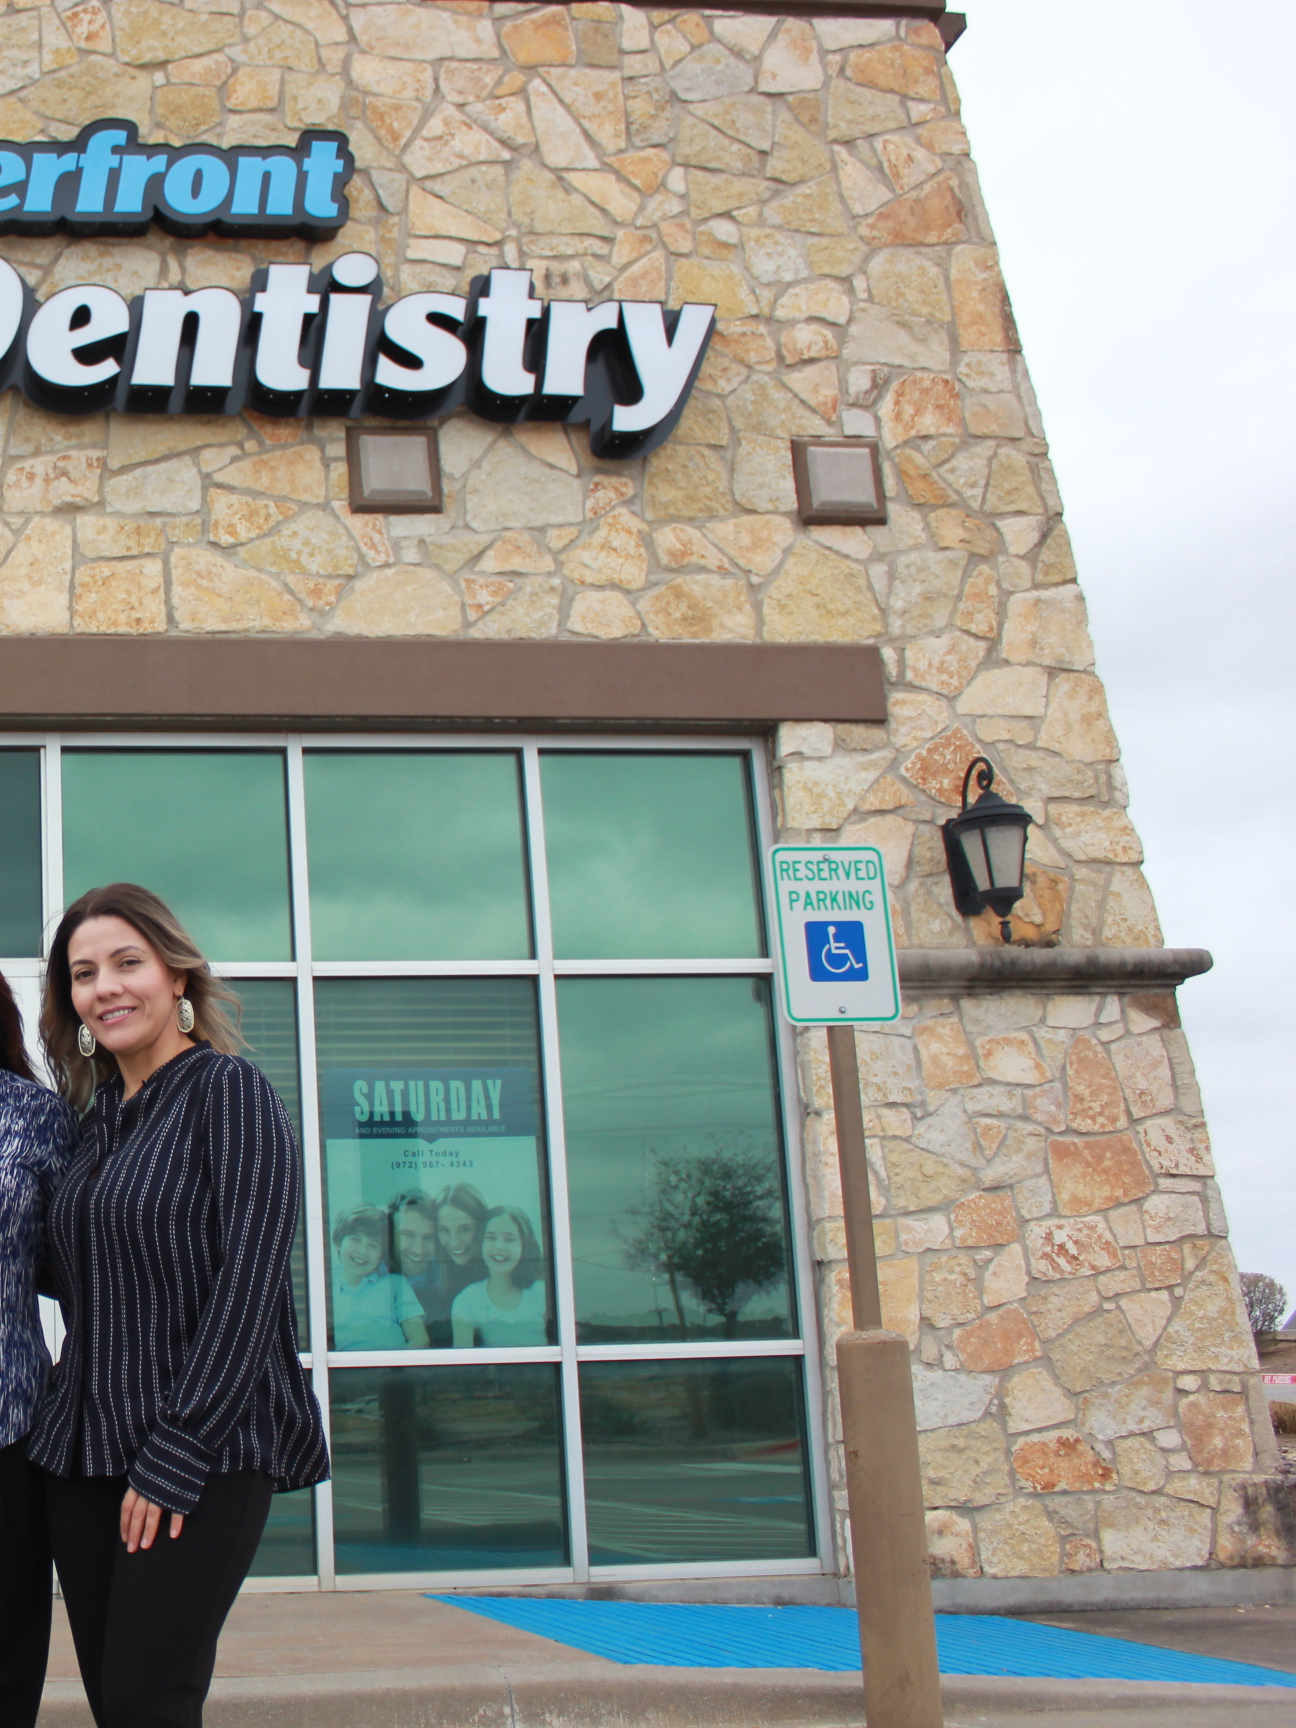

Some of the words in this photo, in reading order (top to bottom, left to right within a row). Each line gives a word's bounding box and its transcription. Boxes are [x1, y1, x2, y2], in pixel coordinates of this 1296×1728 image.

[779, 860, 878, 881] RESERVED
[788, 890, 874, 911] PARKING
[353, 1079, 502, 1122] SATURDAY
[408, 1126, 465, 1134] APPOINTMENTS
[466, 1125, 506, 1133] AVAILABLE
[403, 1150, 424, 1158] Call
[429, 1150, 460, 1159] Today
[391, 1161, 418, 1170] (972)
[449, 1160, 474, 1168] 4343
